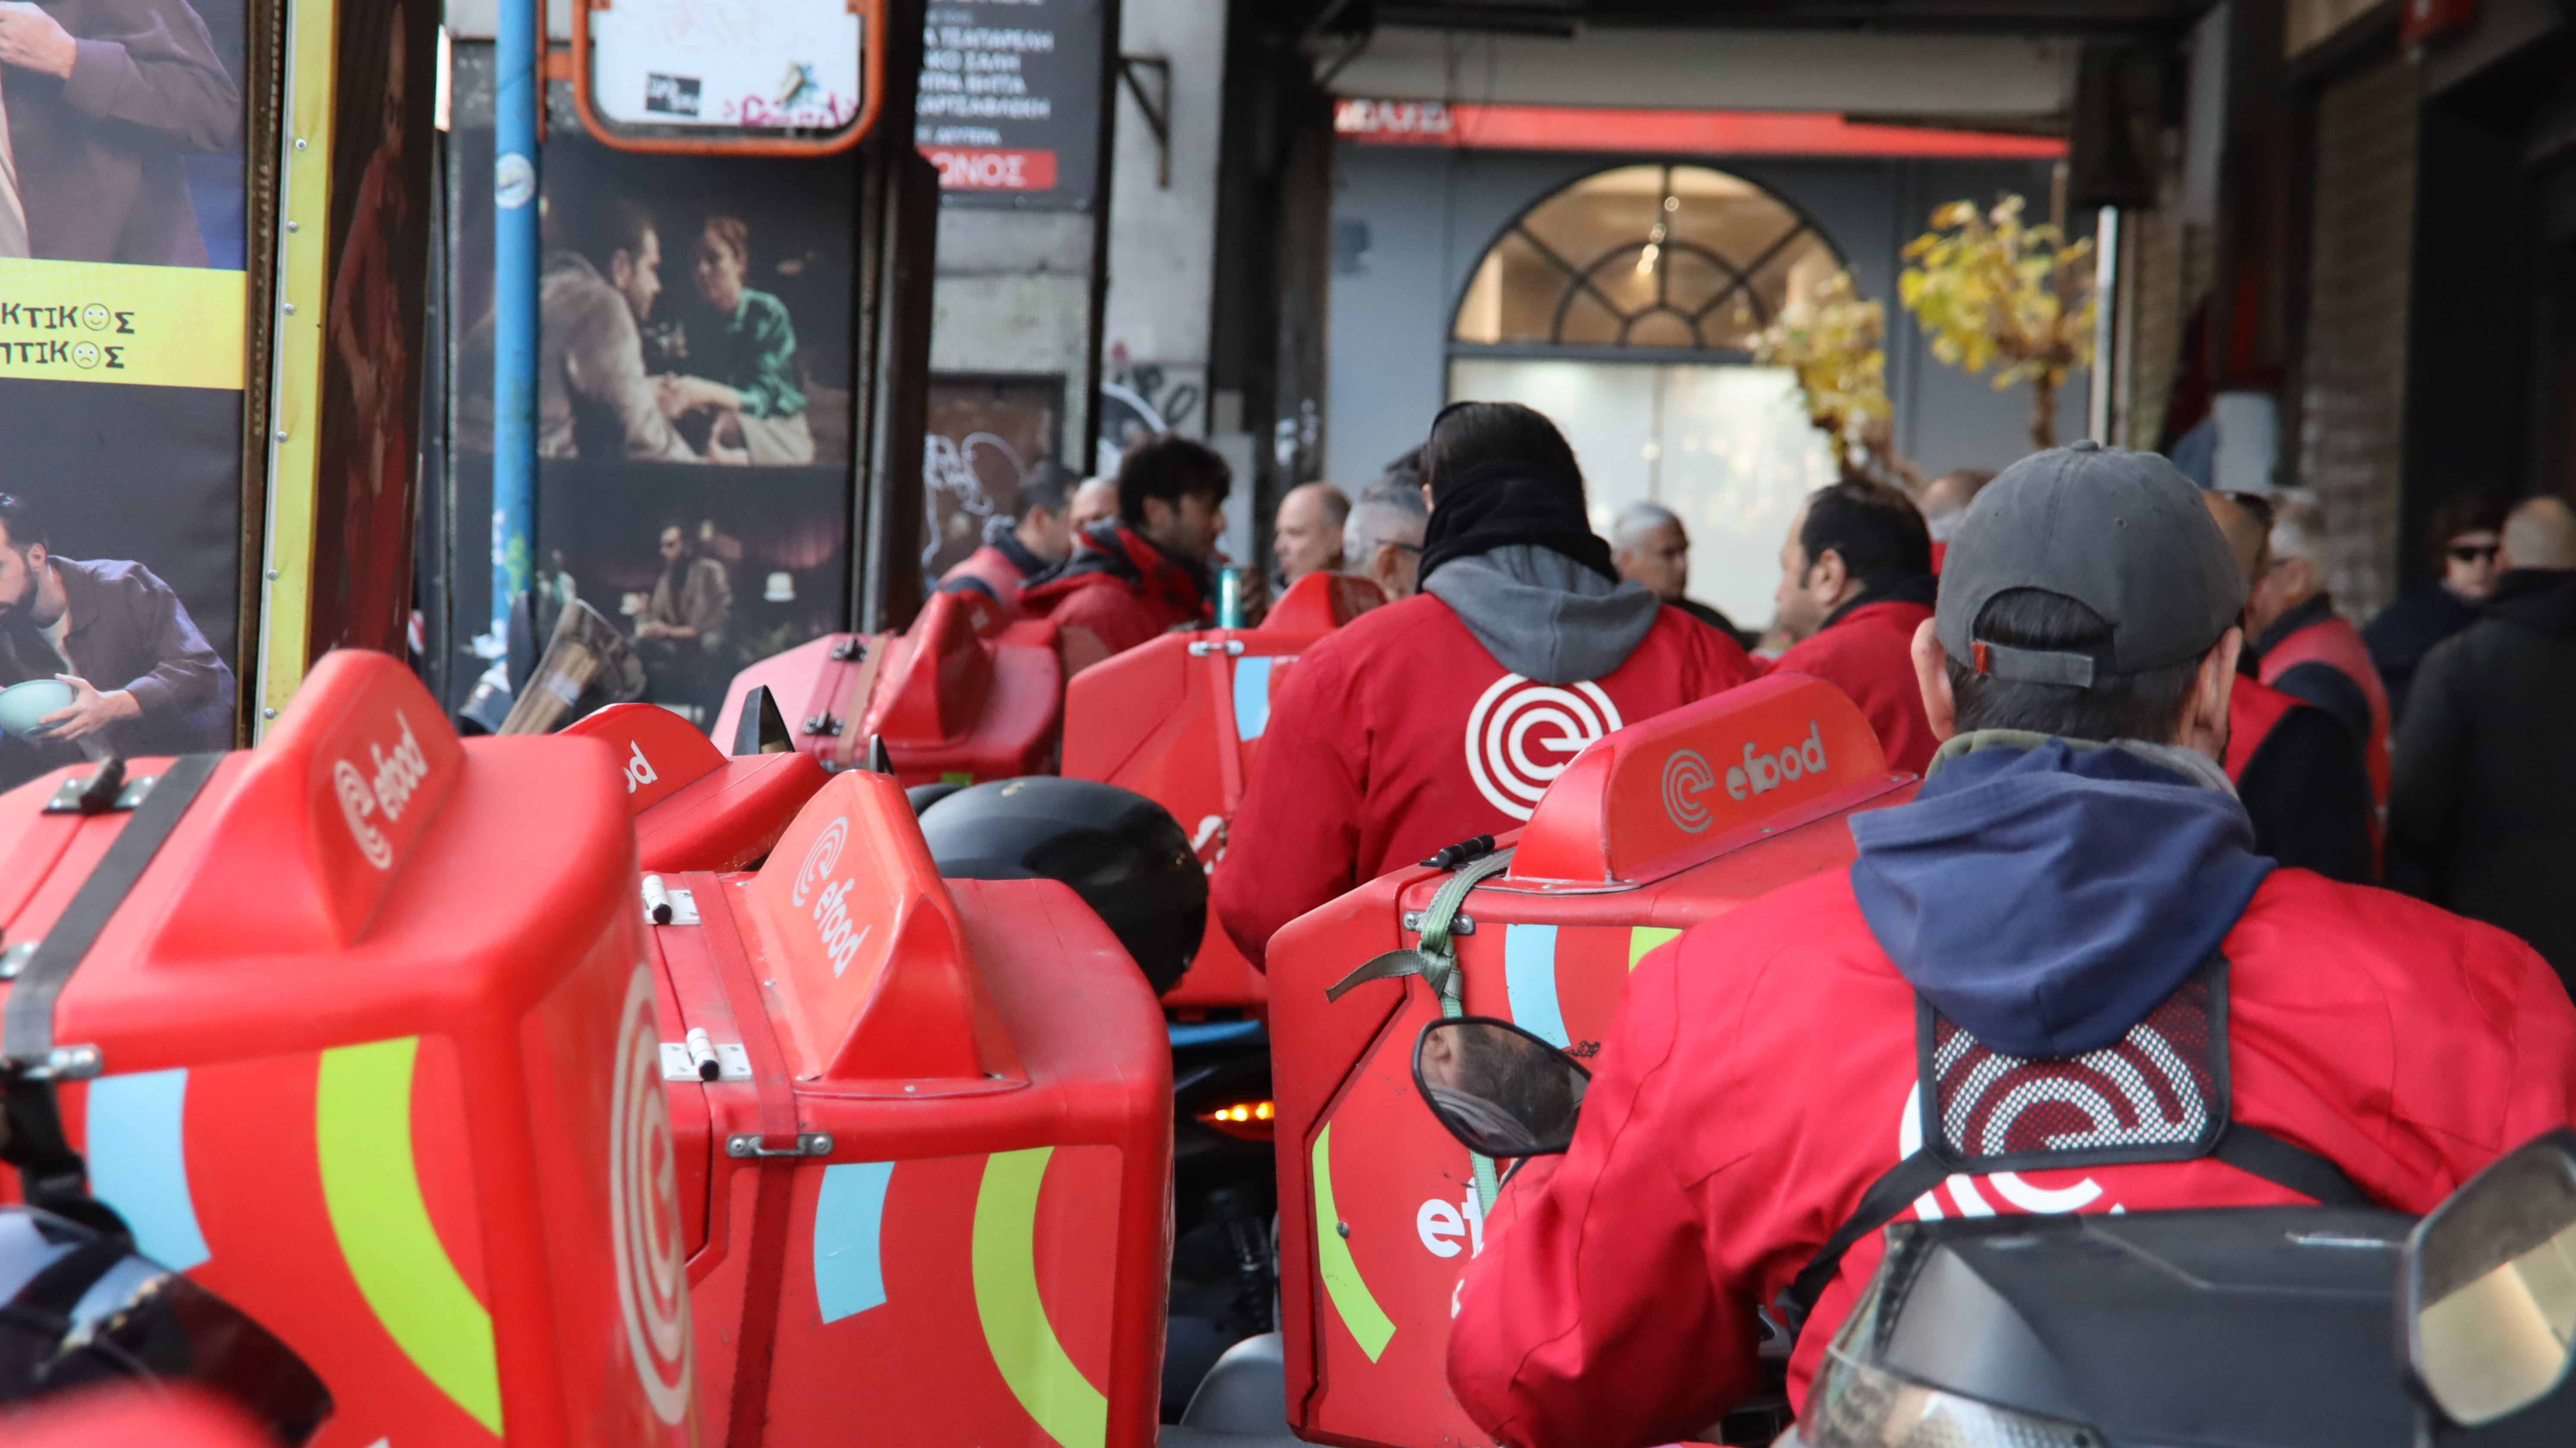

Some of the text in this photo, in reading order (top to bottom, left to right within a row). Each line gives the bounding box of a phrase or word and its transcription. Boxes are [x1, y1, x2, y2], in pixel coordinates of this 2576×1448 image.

[370, 709, 428, 822] efood
[1726, 718, 1827, 800] efood
[814, 878, 872, 979] efood
